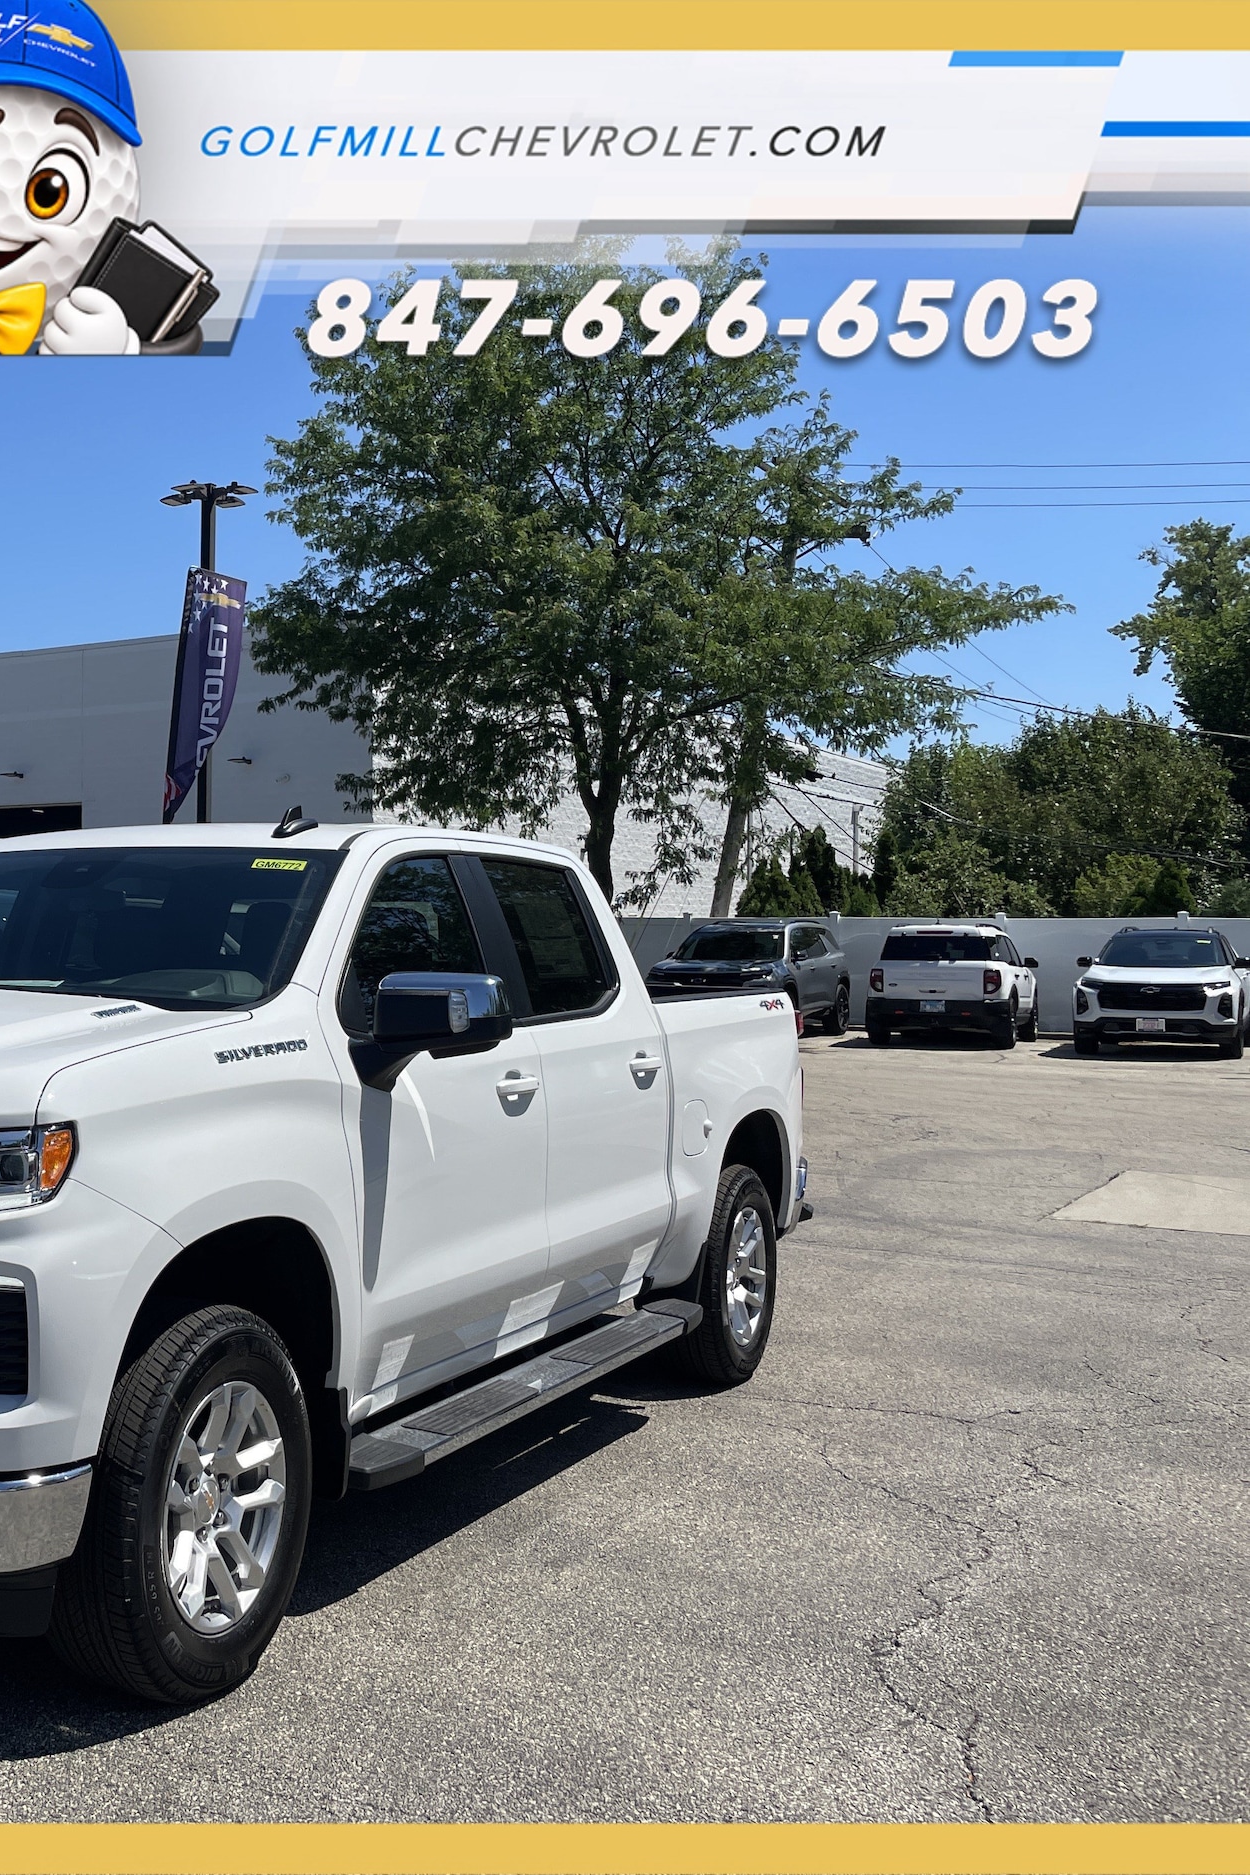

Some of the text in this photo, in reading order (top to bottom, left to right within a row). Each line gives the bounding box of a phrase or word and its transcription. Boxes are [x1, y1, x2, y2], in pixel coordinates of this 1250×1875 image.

[195, 617, 228, 776] EVROLET
[255, 861, 302, 870] GM6772
[214, 1039, 308, 1064] SILVERADO
